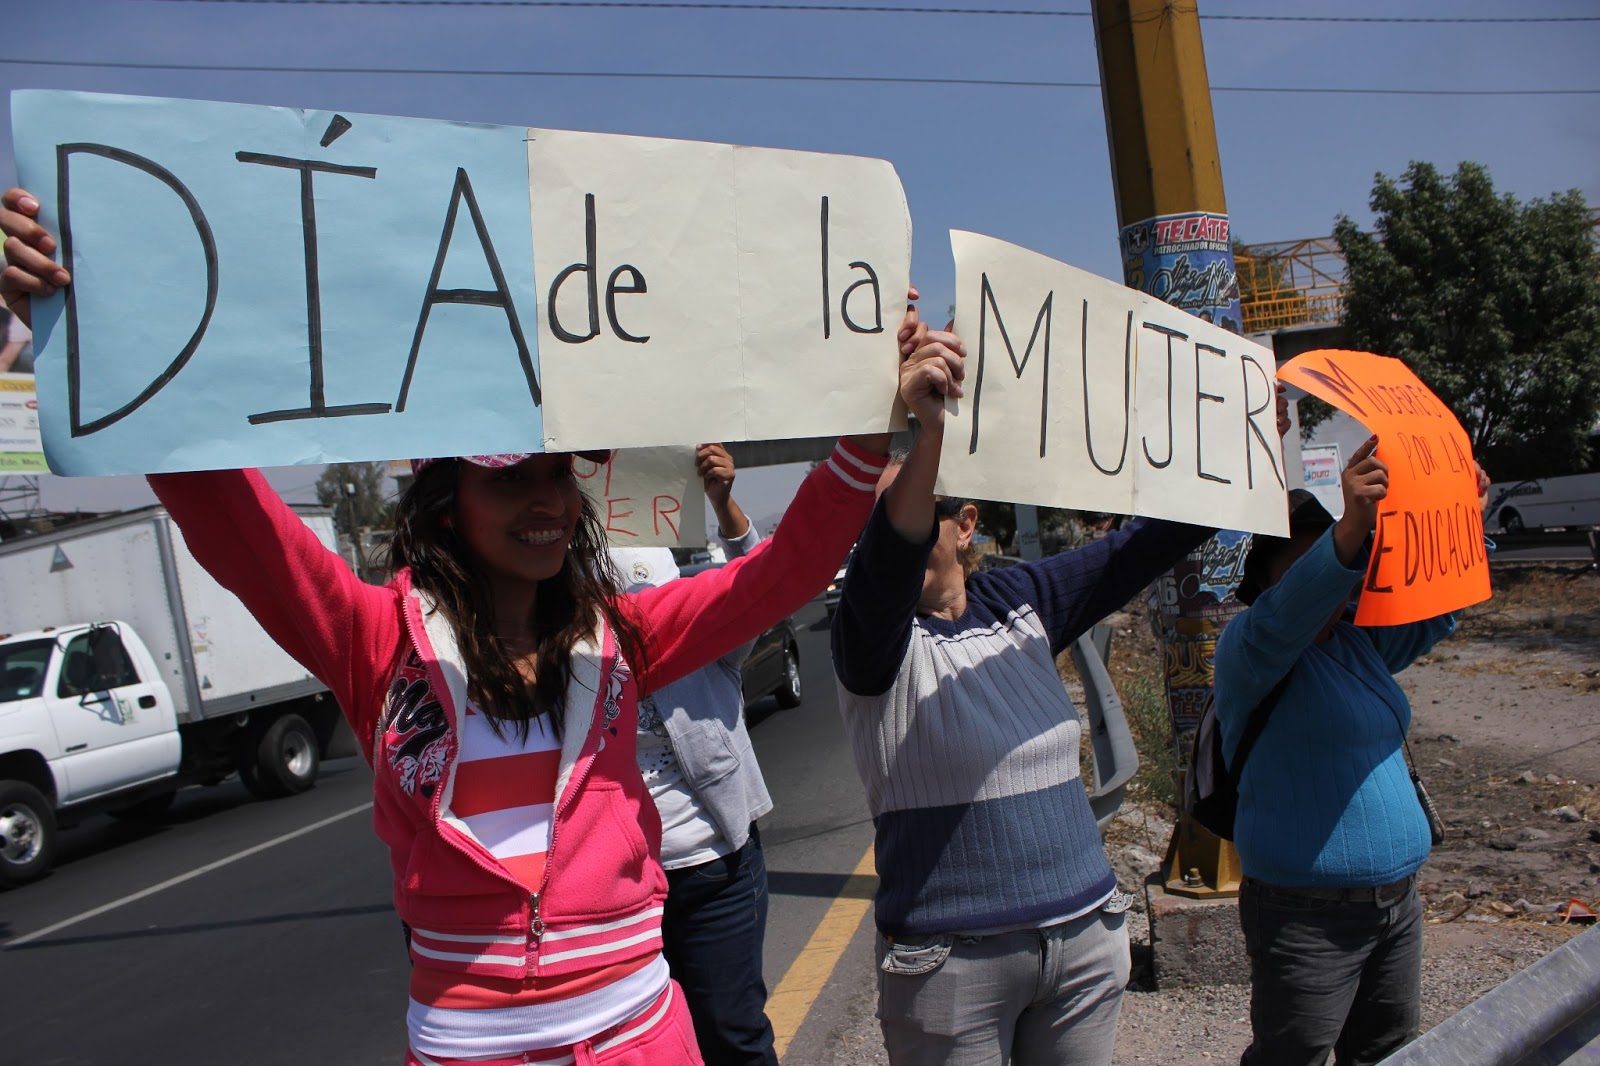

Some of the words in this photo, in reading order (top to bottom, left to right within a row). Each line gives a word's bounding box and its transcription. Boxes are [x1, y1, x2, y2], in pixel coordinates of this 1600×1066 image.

[1152, 215, 1229, 244] TECATE
[1154, 241, 1208, 255] PATROCINADOR
[1209, 241, 1228, 251] OFICIAL
[57, 114, 541, 437] DÍA
[548, 193, 650, 343] de
[820, 196, 884, 339] la
[969, 272, 1284, 491] MUJER
[571, 448, 620, 497] OY
[1397, 431, 1440, 480] POR
[1440, 431, 1472, 479] LA
[606, 495, 681, 541] ER
[1365, 502, 1486, 593] EDUCACIO
